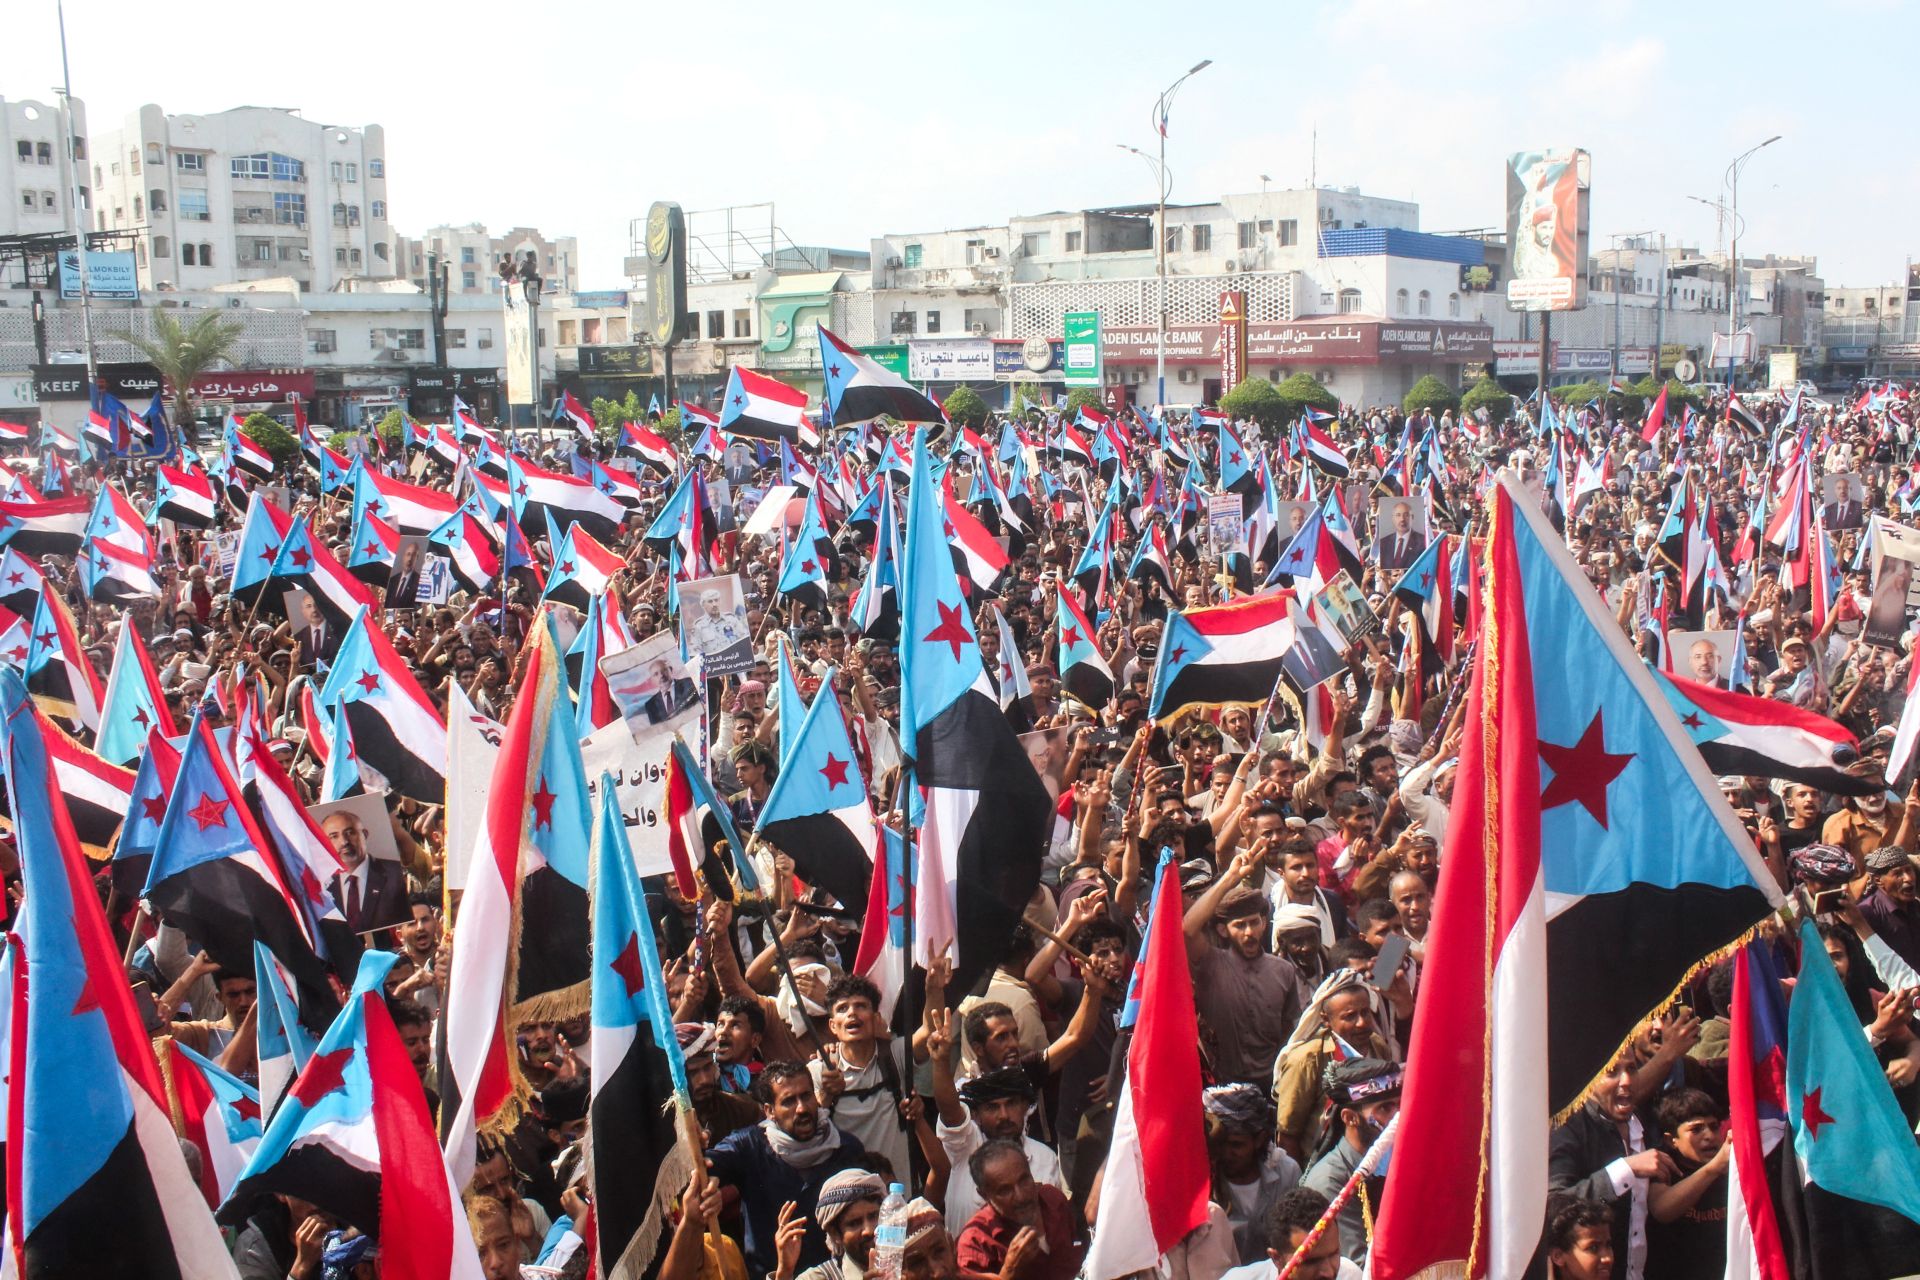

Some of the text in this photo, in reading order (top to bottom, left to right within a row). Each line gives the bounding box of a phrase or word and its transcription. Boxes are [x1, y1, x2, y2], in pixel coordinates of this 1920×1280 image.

[1102, 331, 1203, 345] ADEN ISLAMC BANK
[1248, 326, 1361, 345] بنك عدن الإسلامي
[1382, 329, 1397, 342] ADEN
[1416, 330, 1431, 342] BANK
[1139, 347, 1153, 356] FOR
[1248, 344, 1313, 354] للتمويل الأصغ
[920, 351, 954, 367] للتجارة
[120, 378, 159, 390] كييف
[416, 378, 443, 387] Shawarma
[473, 375, 496, 385] شاورما
[41, 381, 80, 393] KEEF
[247, 381, 279, 397] هاي
[723, 652, 740, 662] الرئيس
[1375, 724, 1390, 732] CERT
[622, 806, 658, 828] والح
